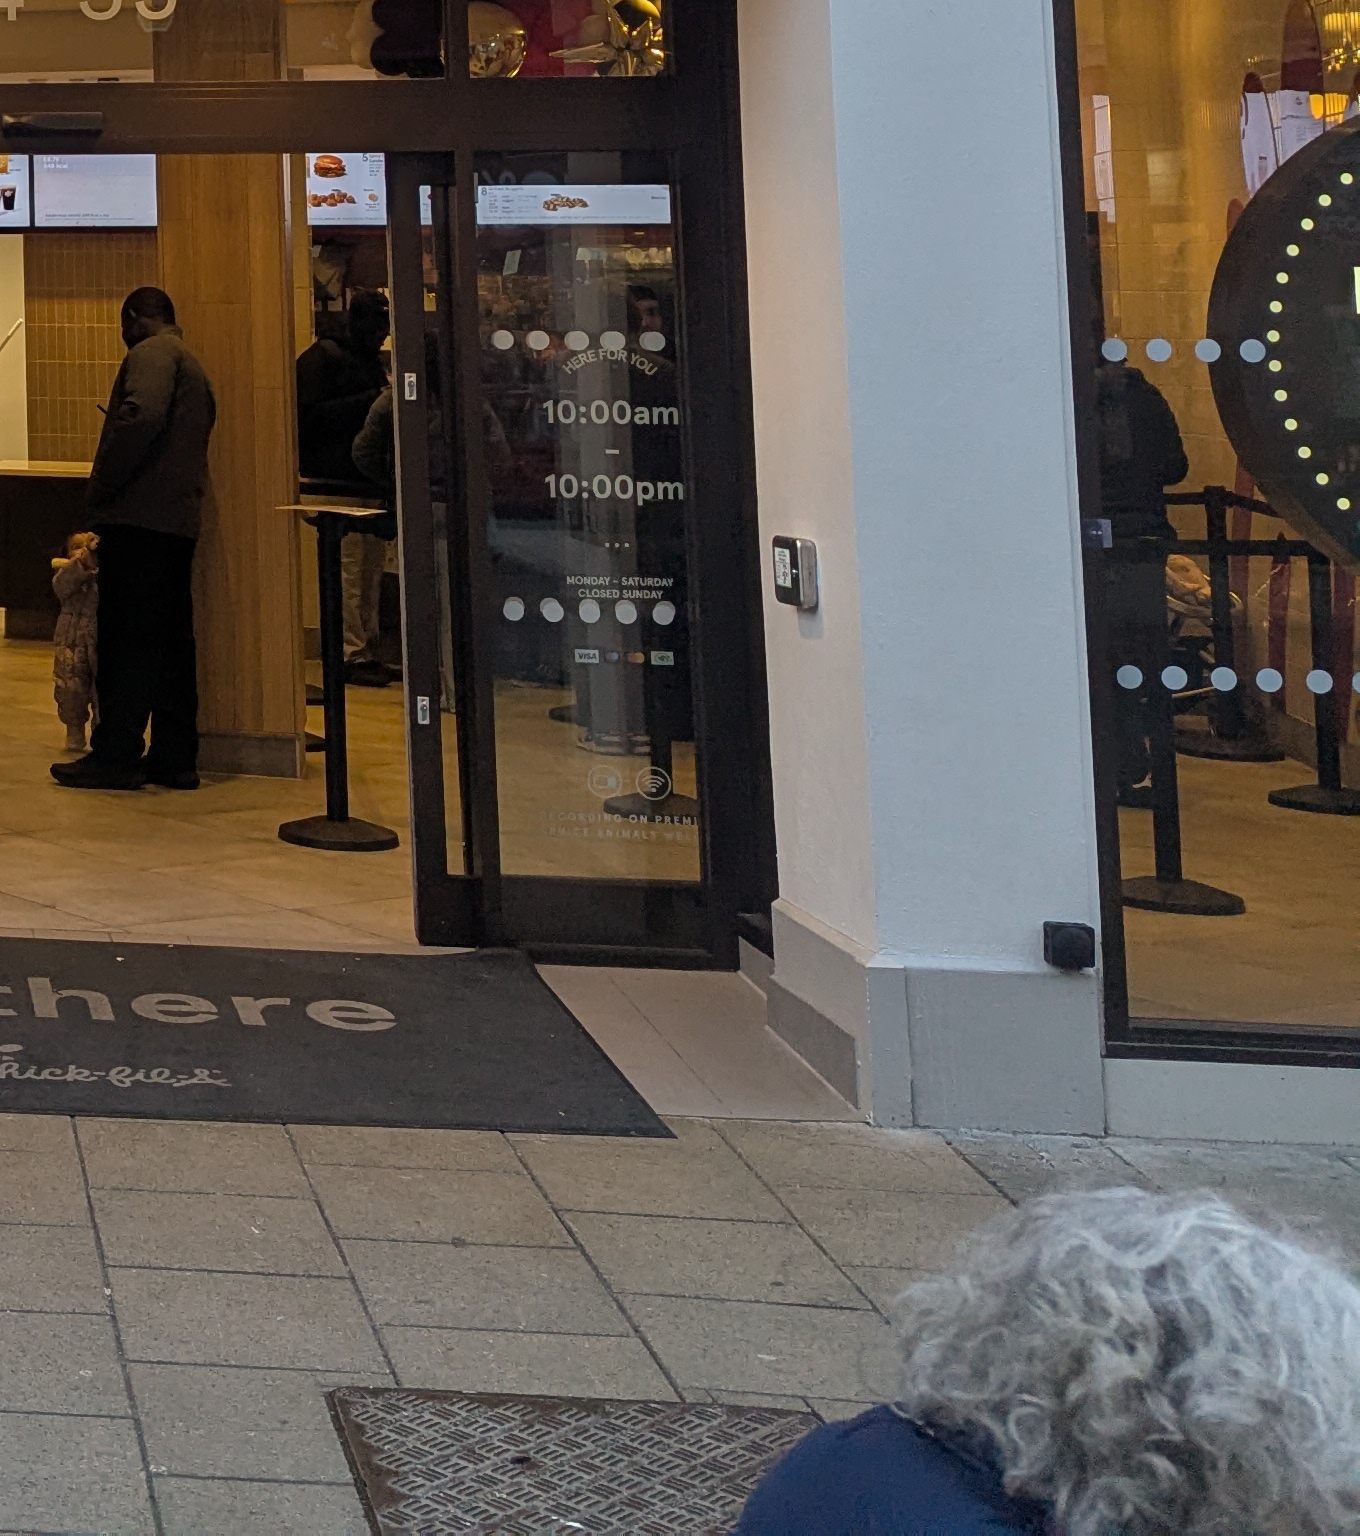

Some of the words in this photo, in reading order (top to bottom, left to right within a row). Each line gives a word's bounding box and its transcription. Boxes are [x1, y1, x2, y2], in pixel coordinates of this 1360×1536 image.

[562, 350, 597, 375] HERE
[599, 348, 628, 362] FOR
[630, 352, 659, 376] YOU
[542, 399, 680, 426] 10:00am
[544, 474, 685, 506] 10:00pm
[566, 575, 611, 586] MONDAY
[621, 576, 674, 587] SATURDAY
[578, 588, 620, 599] CLOSED
[622, 589, 664, 600] SUNDAY
[577, 652, 597, 660] VISA
